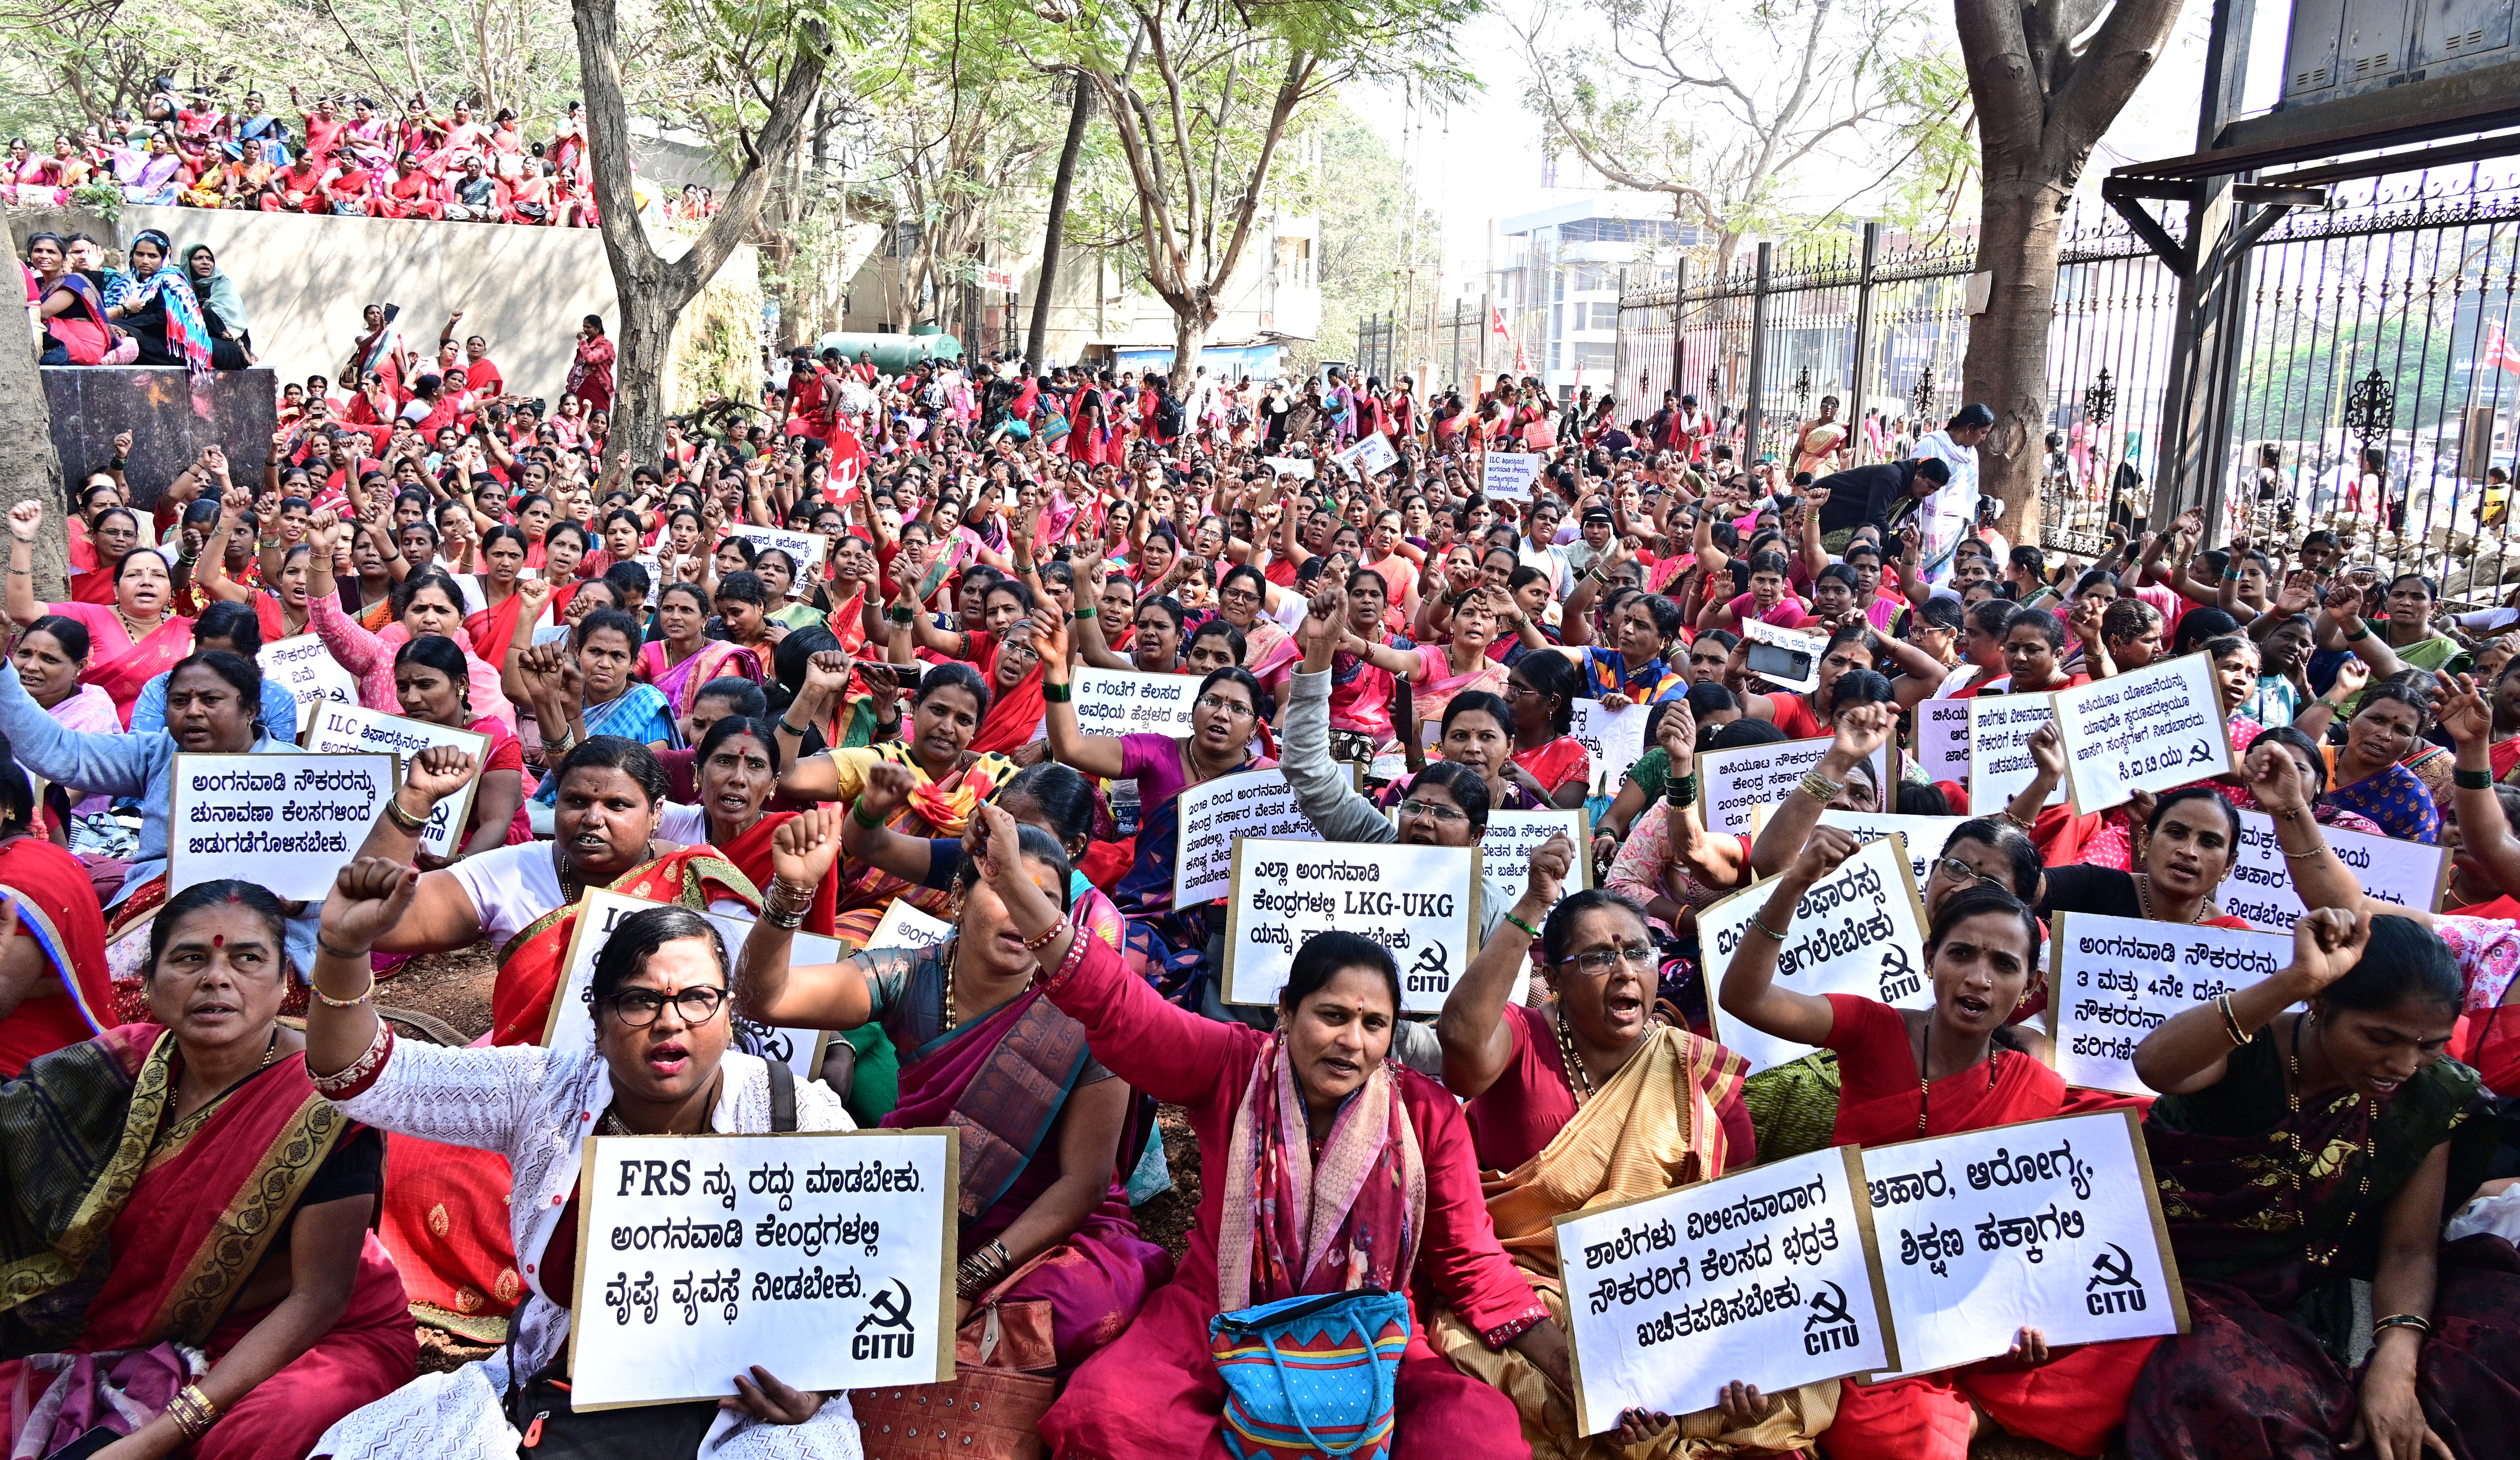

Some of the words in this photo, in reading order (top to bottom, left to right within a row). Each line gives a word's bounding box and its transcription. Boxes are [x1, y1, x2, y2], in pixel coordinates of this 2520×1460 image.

[776, 537, 811, 557] ಆರೋಗ್ಯ,
[643, 562, 662, 571] FRS
[1754, 627, 1774, 640] FRS
[1778, 637, 1788, 647] ನ್ನು
[1792, 639, 1805, 654] ರದ್ದು
[1097, 680, 1136, 696] ಗಂಟೆಗೆ
[1141, 683, 1181, 700] ಕೆಲಸದ
[2078, 693, 2119, 714] ಬಿಸಿಯೂಟ
[2124, 673, 2187, 703] ಯೋಜನೆಯನ್ನು
[327, 714, 357, 734] ILC
[1079, 702, 1125, 720] ಅವಧಿಯ
[1978, 708, 2007, 727] ಶಾಲೆಗಳು
[2084, 713, 2120, 735] ಯಾವುದೇ
[1977, 735, 2008, 752] ನೌಕರರಿಗೆ
[2077, 742, 2103, 760] ಖಾಸಗಿ
[2106, 730, 2150, 755] ಸಂಸ್ಥೆಗಳಿಗೆ
[2153, 716, 2207, 740] ನೀಡಬಾರದು.
[1720, 759, 1770, 774] ಬಿಸಿಯೂಟ
[193, 770, 286, 791] ಅಂಗನವಾಡಿ
[295, 769, 375, 801] ನೌಕರರನ್ನು
[1733, 774, 1763, 790] ಕೇಂದ್ರ
[191, 801, 273, 822] ಚುನಾವಣಾ
[282, 800, 370, 821] ಕೆಲಸಗಳಿಂದ
[1189, 800, 1207, 815] 2018
[1212, 789, 1232, 805] ರಿಂದ
[1238, 783, 1290, 799] ಅಂಗನವಾಡಿ
[1188, 818, 1210, 833] ಕೇಂದ್ರ
[1216, 805, 1250, 824] ಸರ್ಕಾರ
[1255, 801, 1284, 817] ವೇತನ
[190, 831, 350, 853] ಬಿಡುಗಡೆಗೊಳಿಸಬೇಕು.
[423, 827, 445, 842] ITU
[1255, 862, 1288, 888] ಎಲ್ಲಾ
[1297, 859, 1379, 882] ಅಂಗನವಾಡಿ
[1253, 888, 1335, 921] ಕೇಂದ್ರಗಳಲ್ಲಿ
[1344, 891, 1454, 917] LKG-UKG
[1251, 922, 1292, 956] ಯನ್ನು
[1778, 907, 1894, 976] ಆಗಲೇಬೇಕು
[2080, 935, 2175, 962] ಅಂಗನವಾಡಿ
[1407, 975, 1449, 992] CITU
[1880, 975, 1920, 1003] CITU
[2098, 968, 2138, 1000] ಮತ್ತು
[2148, 975, 2183, 997] 4ನೇ
[617, 1159, 691, 1196] FRS
[703, 1162, 736, 1211] ನ್ನು
[749, 1162, 793, 1211] ರದ್ದು
[806, 1160, 924, 1193] ಮಾಡಬೇಕು.
[1866, 1159, 1955, 1210] ಆಹಾರ,
[1967, 1139, 2093, 1200] ಆರೋಗ್ಯ,
[612, 1216, 743, 1251] ಅಂಗನವಾಡಿ
[756, 1213, 879, 1257] ಕೇಂದ್ರಗಳಲ್ಲಿ
[1584, 1218, 1676, 1269] ಶಾಲೆಗಳು
[1687, 1173, 1826, 1240] ವಿಲೀನವಾದಾಗ
[1901, 1222, 1963, 1277] ಶಿಕ್ಷಣ
[1975, 1203, 2084, 1264] ಹಕ್ಕಾಗಲಿ
[1589, 1257, 1690, 1315] ನೌಕರರಿಗೆ
[1700, 1234, 1772, 1288] ಕೆಲಸದ
[1783, 1218, 1838, 1274] ಭದ್ರತೆ
[673, 1268, 740, 1326] ವ್ಯವಸ್ಥೆ
[753, 1265, 866, 1301] ನೀಡಬೇಕು.
[2086, 1287, 2146, 1315] CITU
[1636, 1277, 1807, 1347] ಖಚಿತಪಡಿಸಬೇಕು.
[852, 1333, 914, 1360] CITU
[1804, 1324, 1859, 1357] CITU
